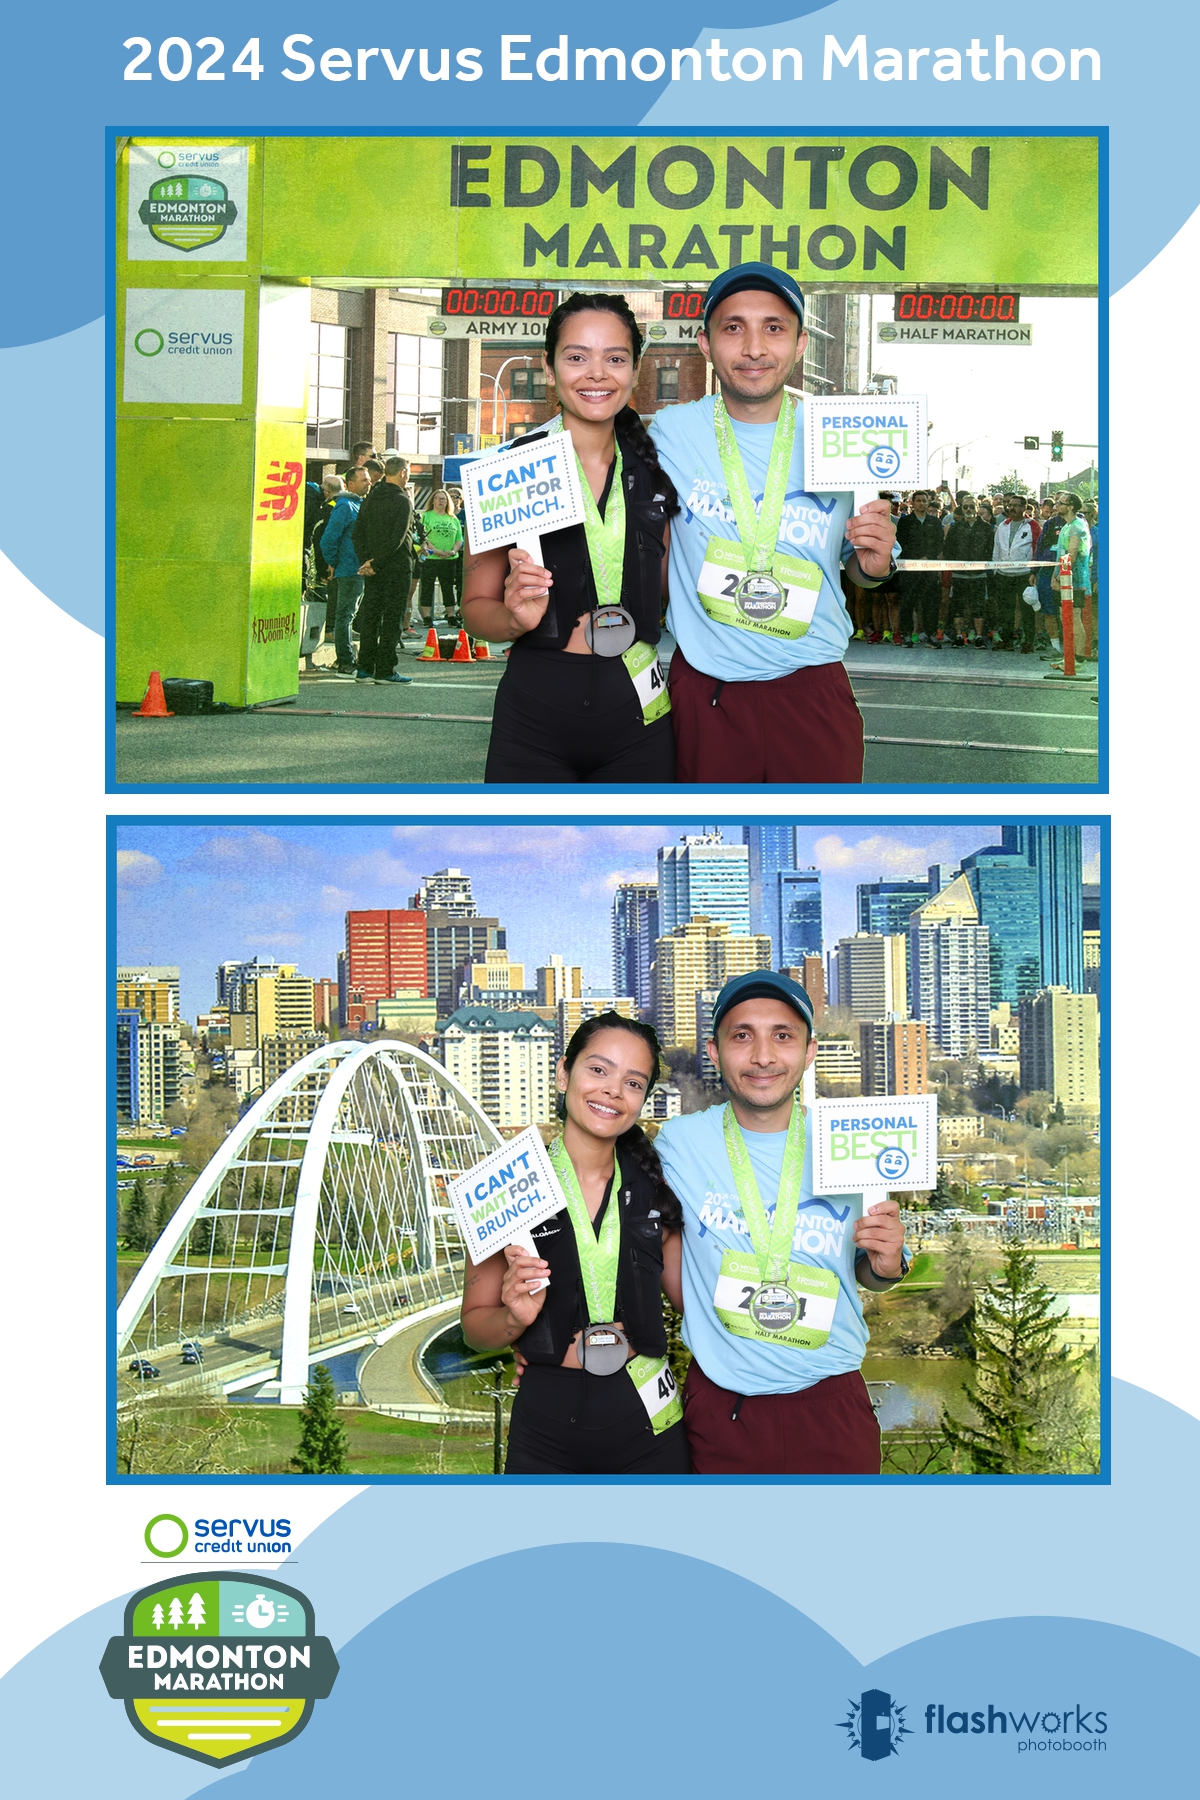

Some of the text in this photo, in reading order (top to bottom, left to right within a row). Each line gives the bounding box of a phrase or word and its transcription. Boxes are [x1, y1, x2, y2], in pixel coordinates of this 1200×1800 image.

[178, 152, 219, 161] servus
[450, 145, 990, 210] EDMONTON
[149, 203, 226, 214] EDMONTON
[160, 214, 215, 222] MARATHON
[523, 223, 906, 271] MARATHON
[465, 321, 518, 335] ARMY
[900, 328, 1031, 341] HALF MARATHON
[167, 331, 233, 345] servus
[167, 345, 233, 355] credit union
[822, 415, 908, 429] PERSONAL
[822, 429, 908, 458] BEST!
[477, 455, 557, 496] I CAN'T
[478, 488, 523, 514] WAIT
[526, 477, 562, 500] FOR
[481, 496, 565, 532] BRUNCH.
[735, 618, 791, 636] HALF MARATHON
[830, 1116, 918, 1131] PERSONAL
[831, 1130, 917, 1161] BEST!
[465, 1150, 530, 1209] I CAN'T
[470, 1171, 540, 1224] WAIT FOR
[476, 1189, 546, 1241] BRUNCH.
[531, 1227, 561, 1238] ALOMON
[755, 1330, 811, 1346] HALF MARATHON
